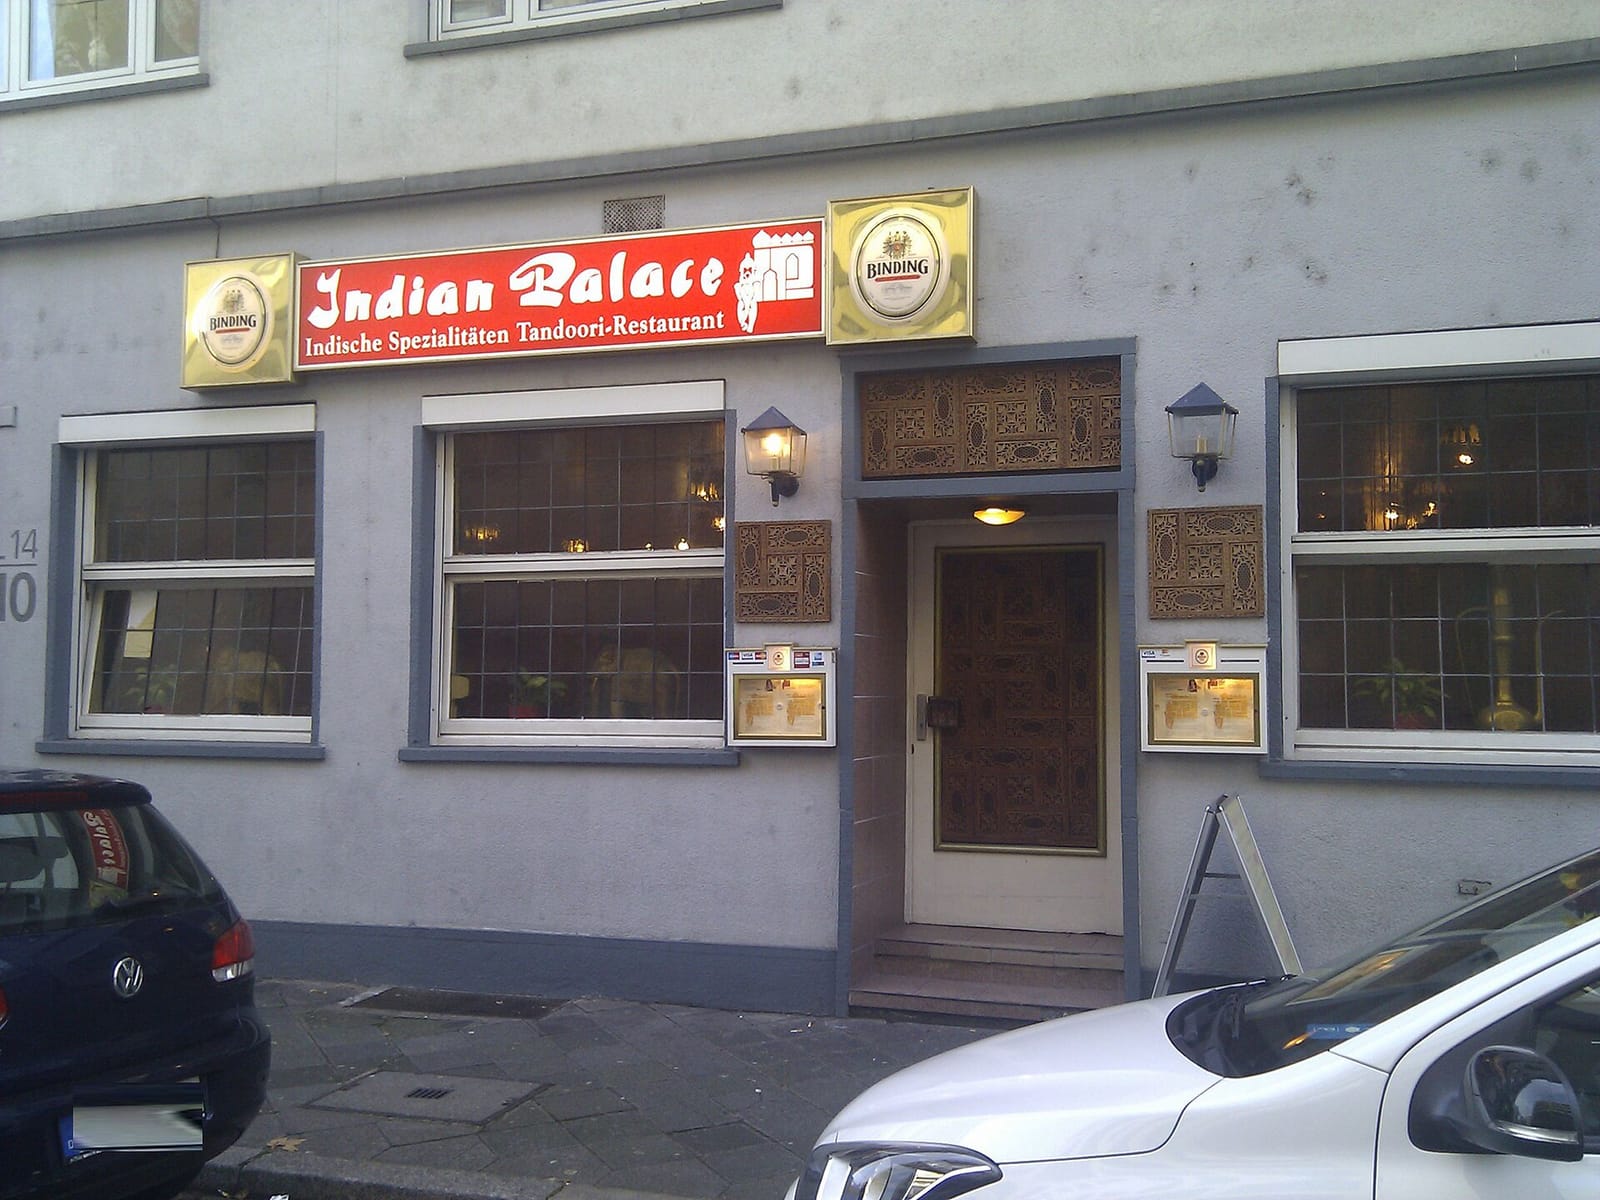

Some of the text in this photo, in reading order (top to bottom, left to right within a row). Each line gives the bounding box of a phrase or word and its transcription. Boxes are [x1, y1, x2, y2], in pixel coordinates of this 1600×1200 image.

[867, 259, 929, 279] BINDING
[307, 252, 725, 328] Indian Palace
[210, 314, 257, 331] BINDING
[306, 311, 725, 356] Indische Spezialitäten Tandoori-Restaurant
[10, 528, 38, 560] 14
